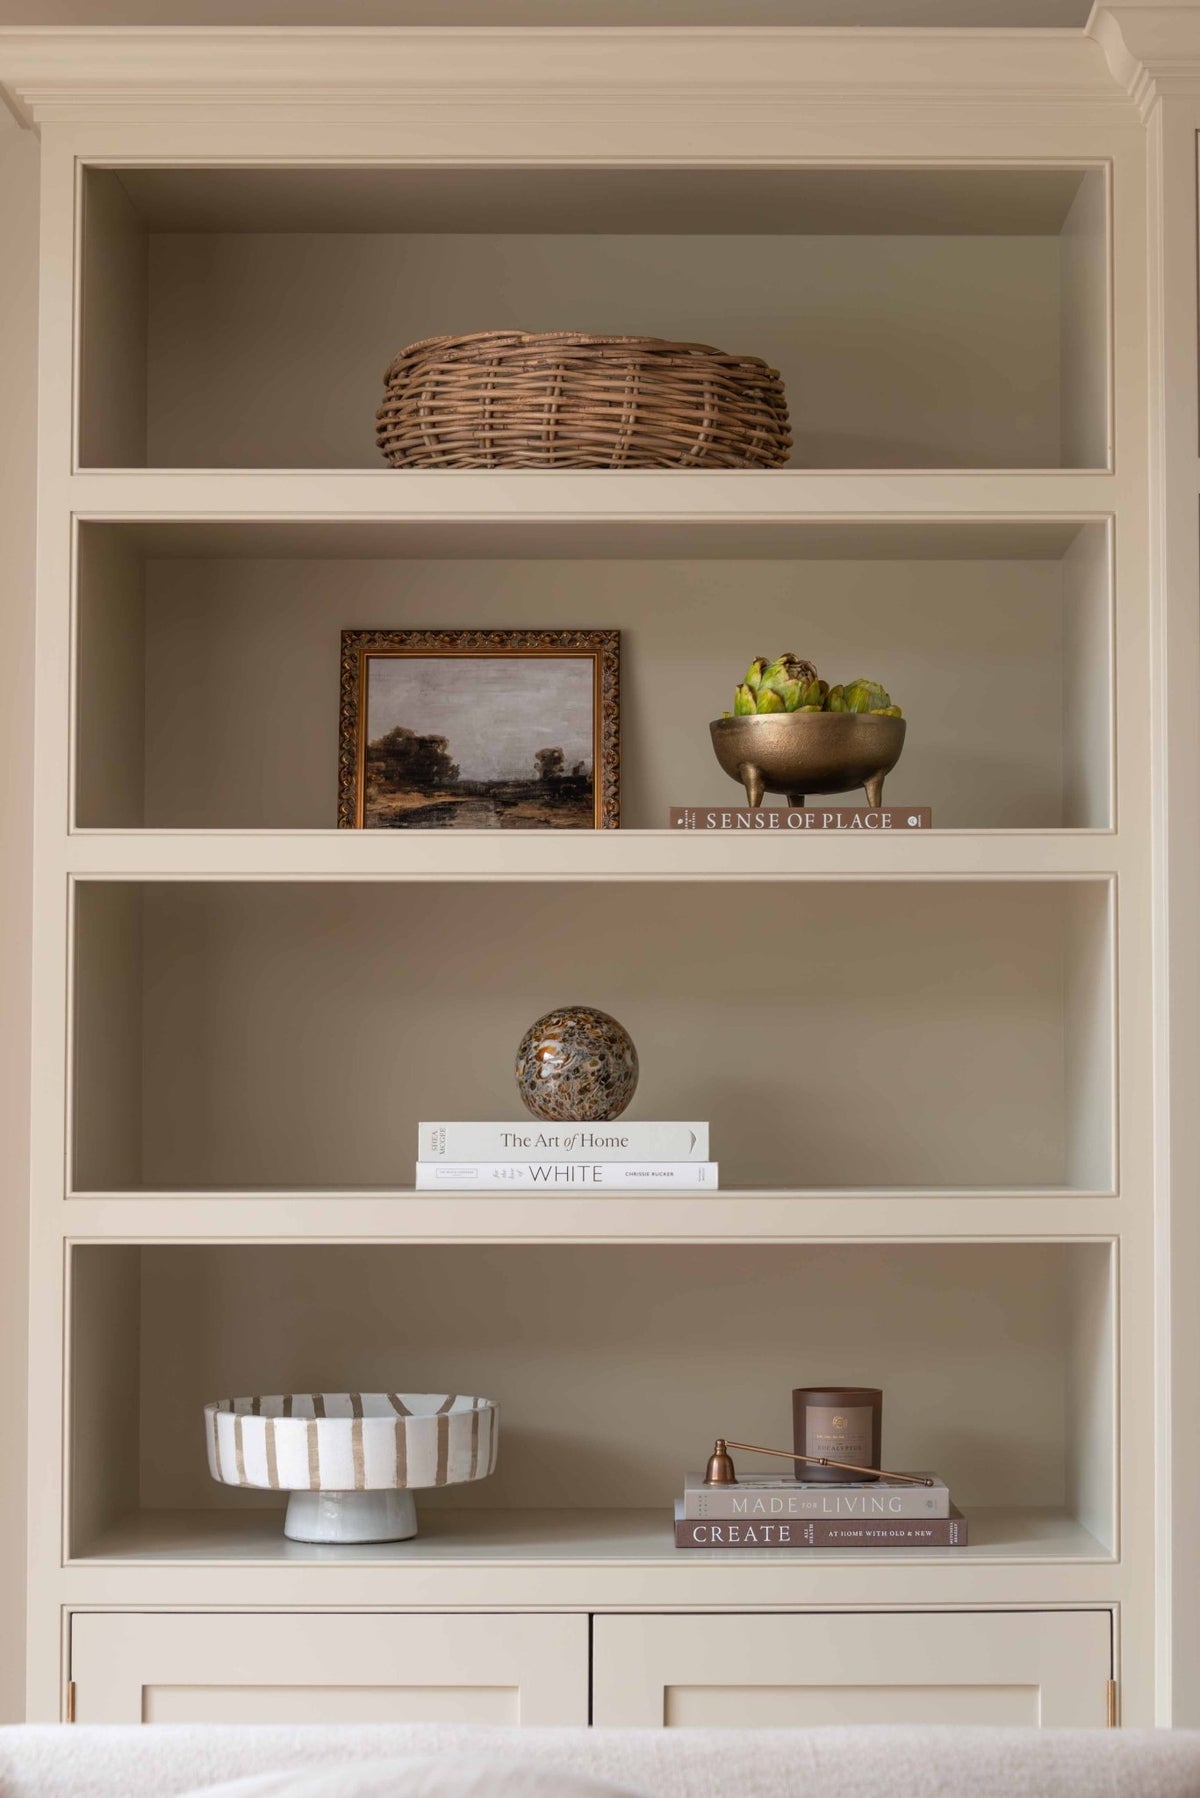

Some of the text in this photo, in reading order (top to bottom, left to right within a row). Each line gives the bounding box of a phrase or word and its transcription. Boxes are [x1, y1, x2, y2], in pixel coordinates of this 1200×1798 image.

[706, 813, 780, 829] SENSE
[787, 813, 815, 829] OF
[822, 813, 892, 829] PLACE
[500, 1133, 629, 1152] The Art of Home
[528, 1165, 603, 1182] WHITE
[732, 1497, 798, 1513] MADE
[823, 1496, 902, 1513] LIVING
[693, 1526, 791, 1542] CREATE
